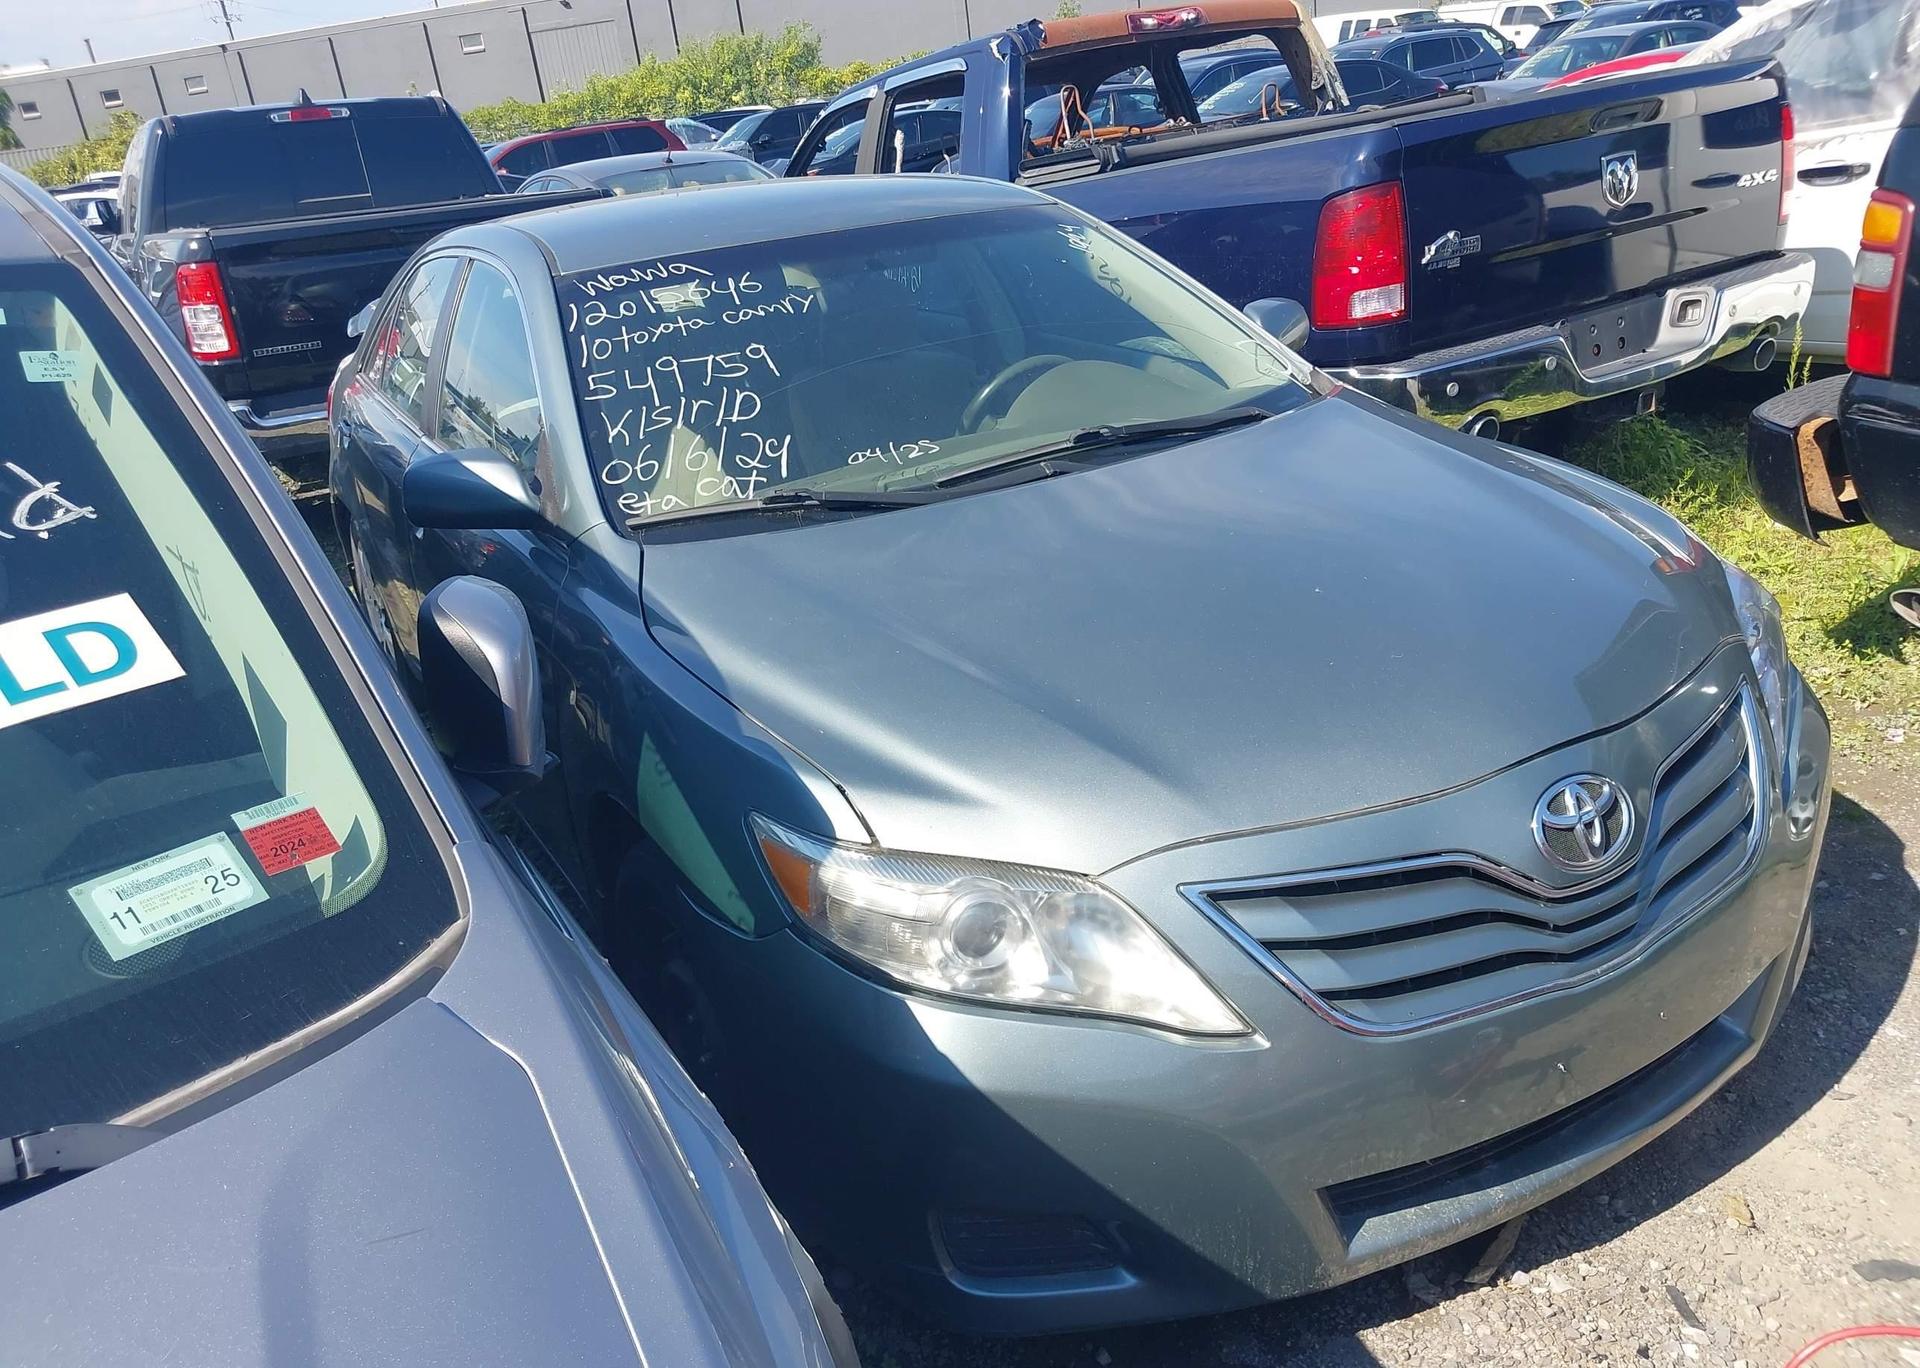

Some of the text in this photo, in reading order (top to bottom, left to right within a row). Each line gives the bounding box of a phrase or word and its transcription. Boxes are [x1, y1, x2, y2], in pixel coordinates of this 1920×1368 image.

[584, 342, 781, 407] 549759
[270, 838, 307, 858] 2024
[131, 853, 171, 872] NEW YORK
[204, 867, 241, 895] 25
[110, 906, 142, 930] 11
[150, 905, 236, 945] VEHICLE REGISTRATION
